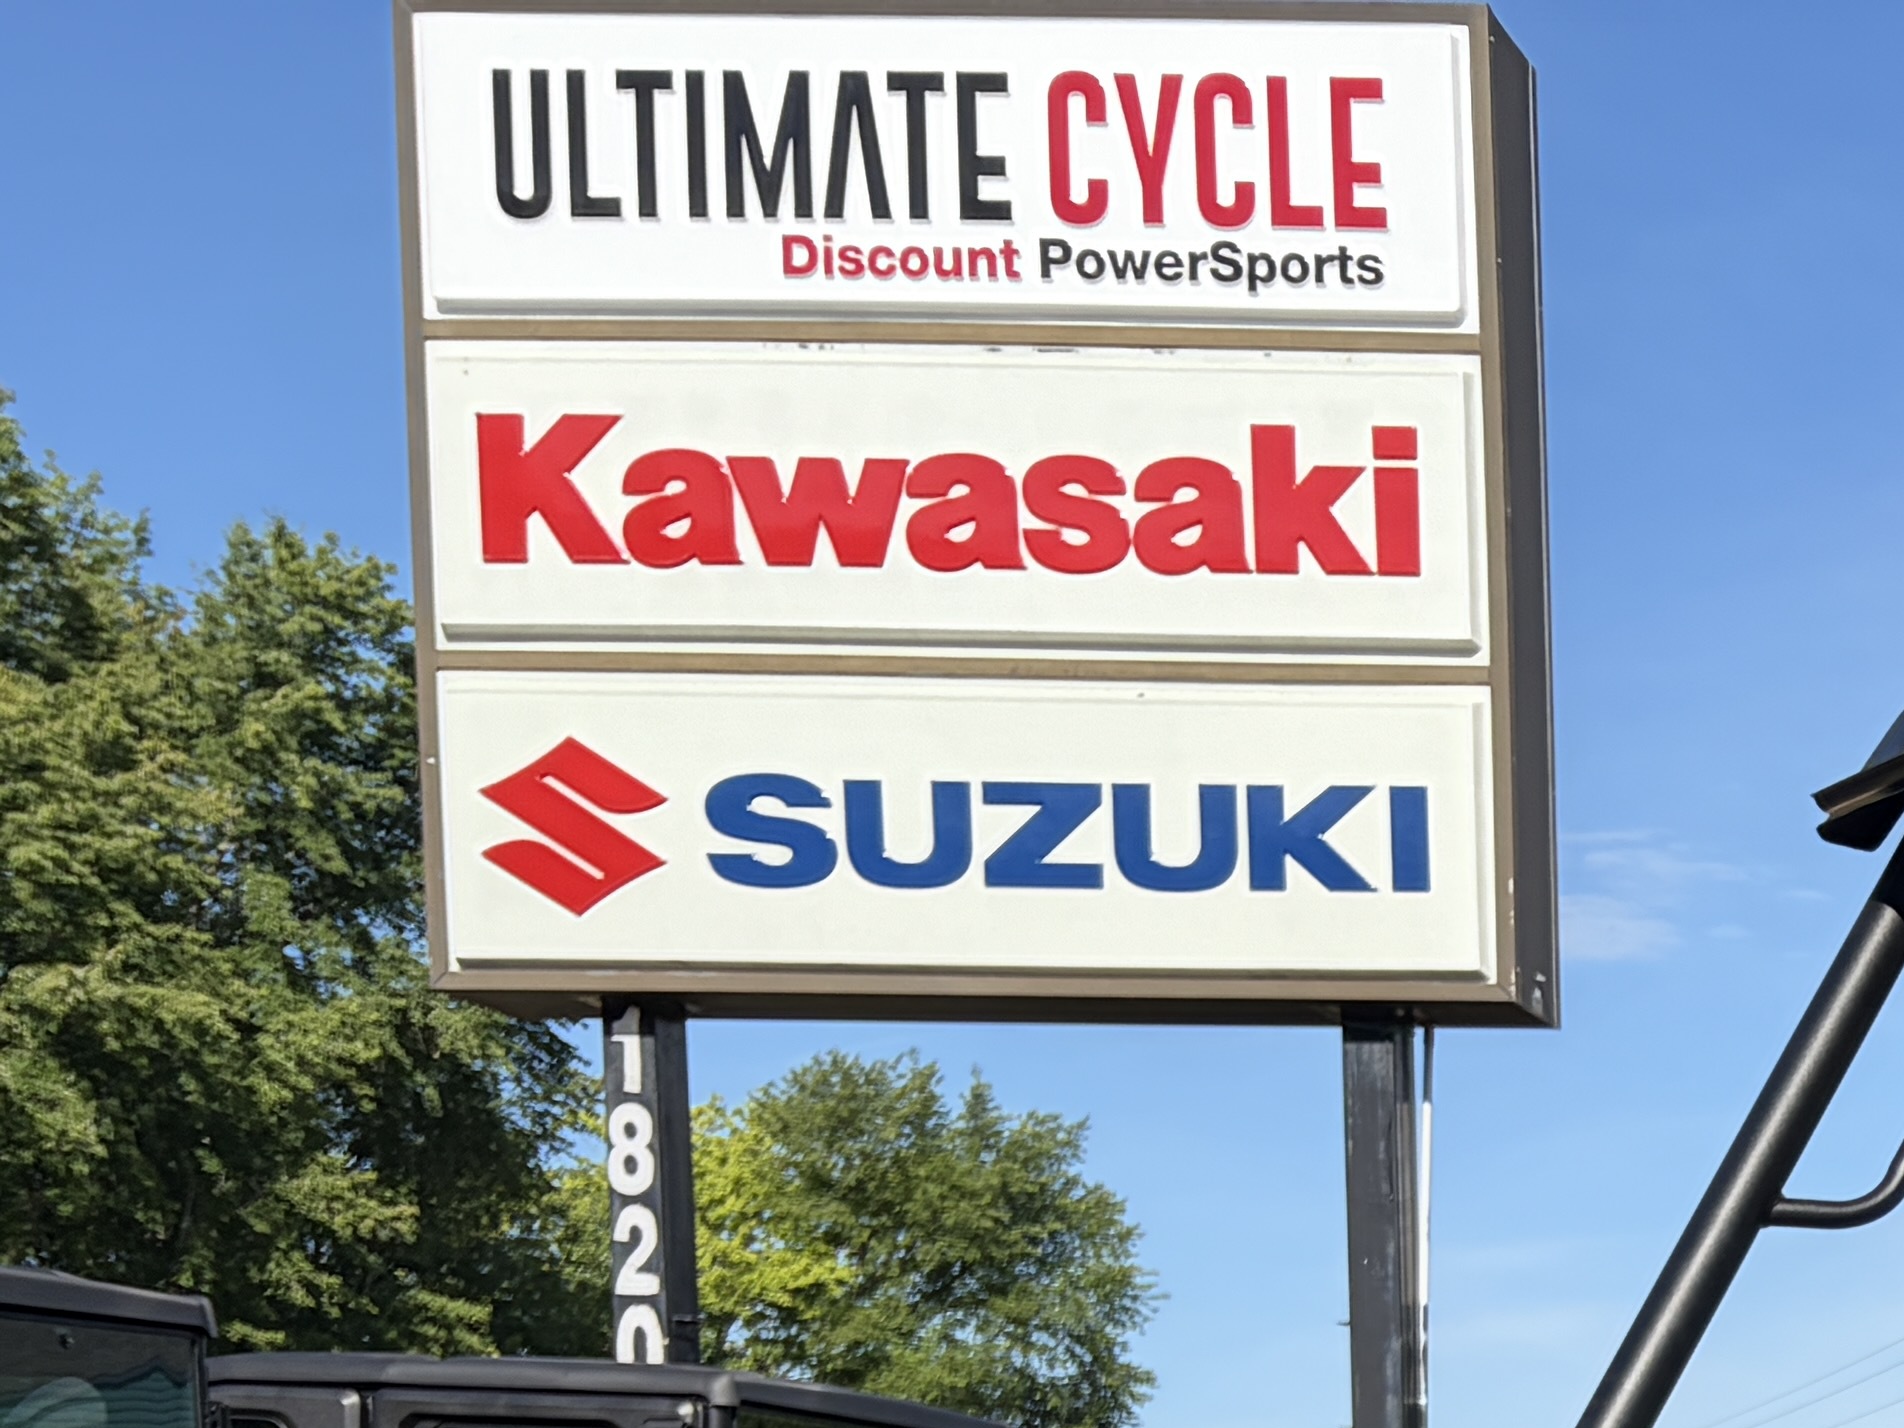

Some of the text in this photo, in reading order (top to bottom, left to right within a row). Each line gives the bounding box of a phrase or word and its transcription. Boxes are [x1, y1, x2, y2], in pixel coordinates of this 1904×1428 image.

[490, 68, 1388, 230] ULTIMATE CYCLE
[780, 234, 1385, 291] Discount PowerSports
[476, 411, 1421, 576] Kawasaki
[703, 772, 1431, 893] SUZUKI
